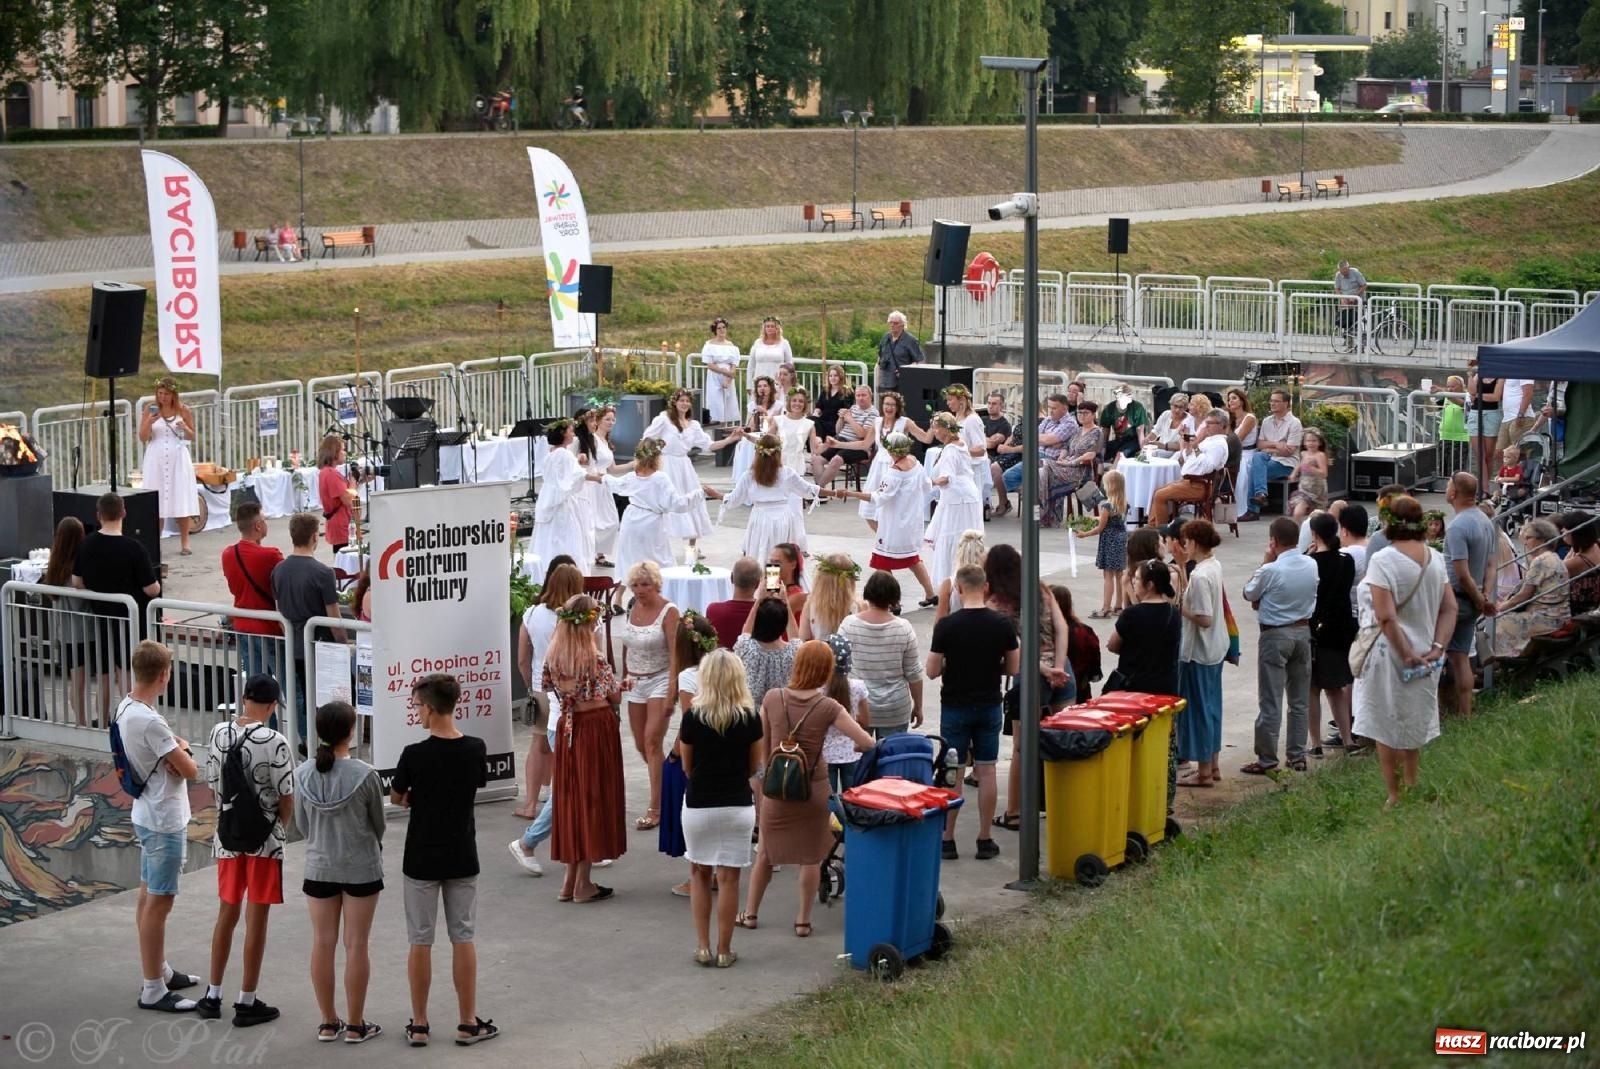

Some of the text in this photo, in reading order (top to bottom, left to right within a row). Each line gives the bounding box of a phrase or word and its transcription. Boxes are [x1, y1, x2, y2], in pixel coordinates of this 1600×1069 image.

[405, 519, 505, 551] Raciborskie
[406, 577, 468, 603] Kultury
[387, 650, 501, 676] ul. Chopina 21
[457, 667, 501, 683] cibórz
[475, 688, 492, 701] 40
[455, 707, 469, 720] 31
[475, 704, 492, 717] 72
